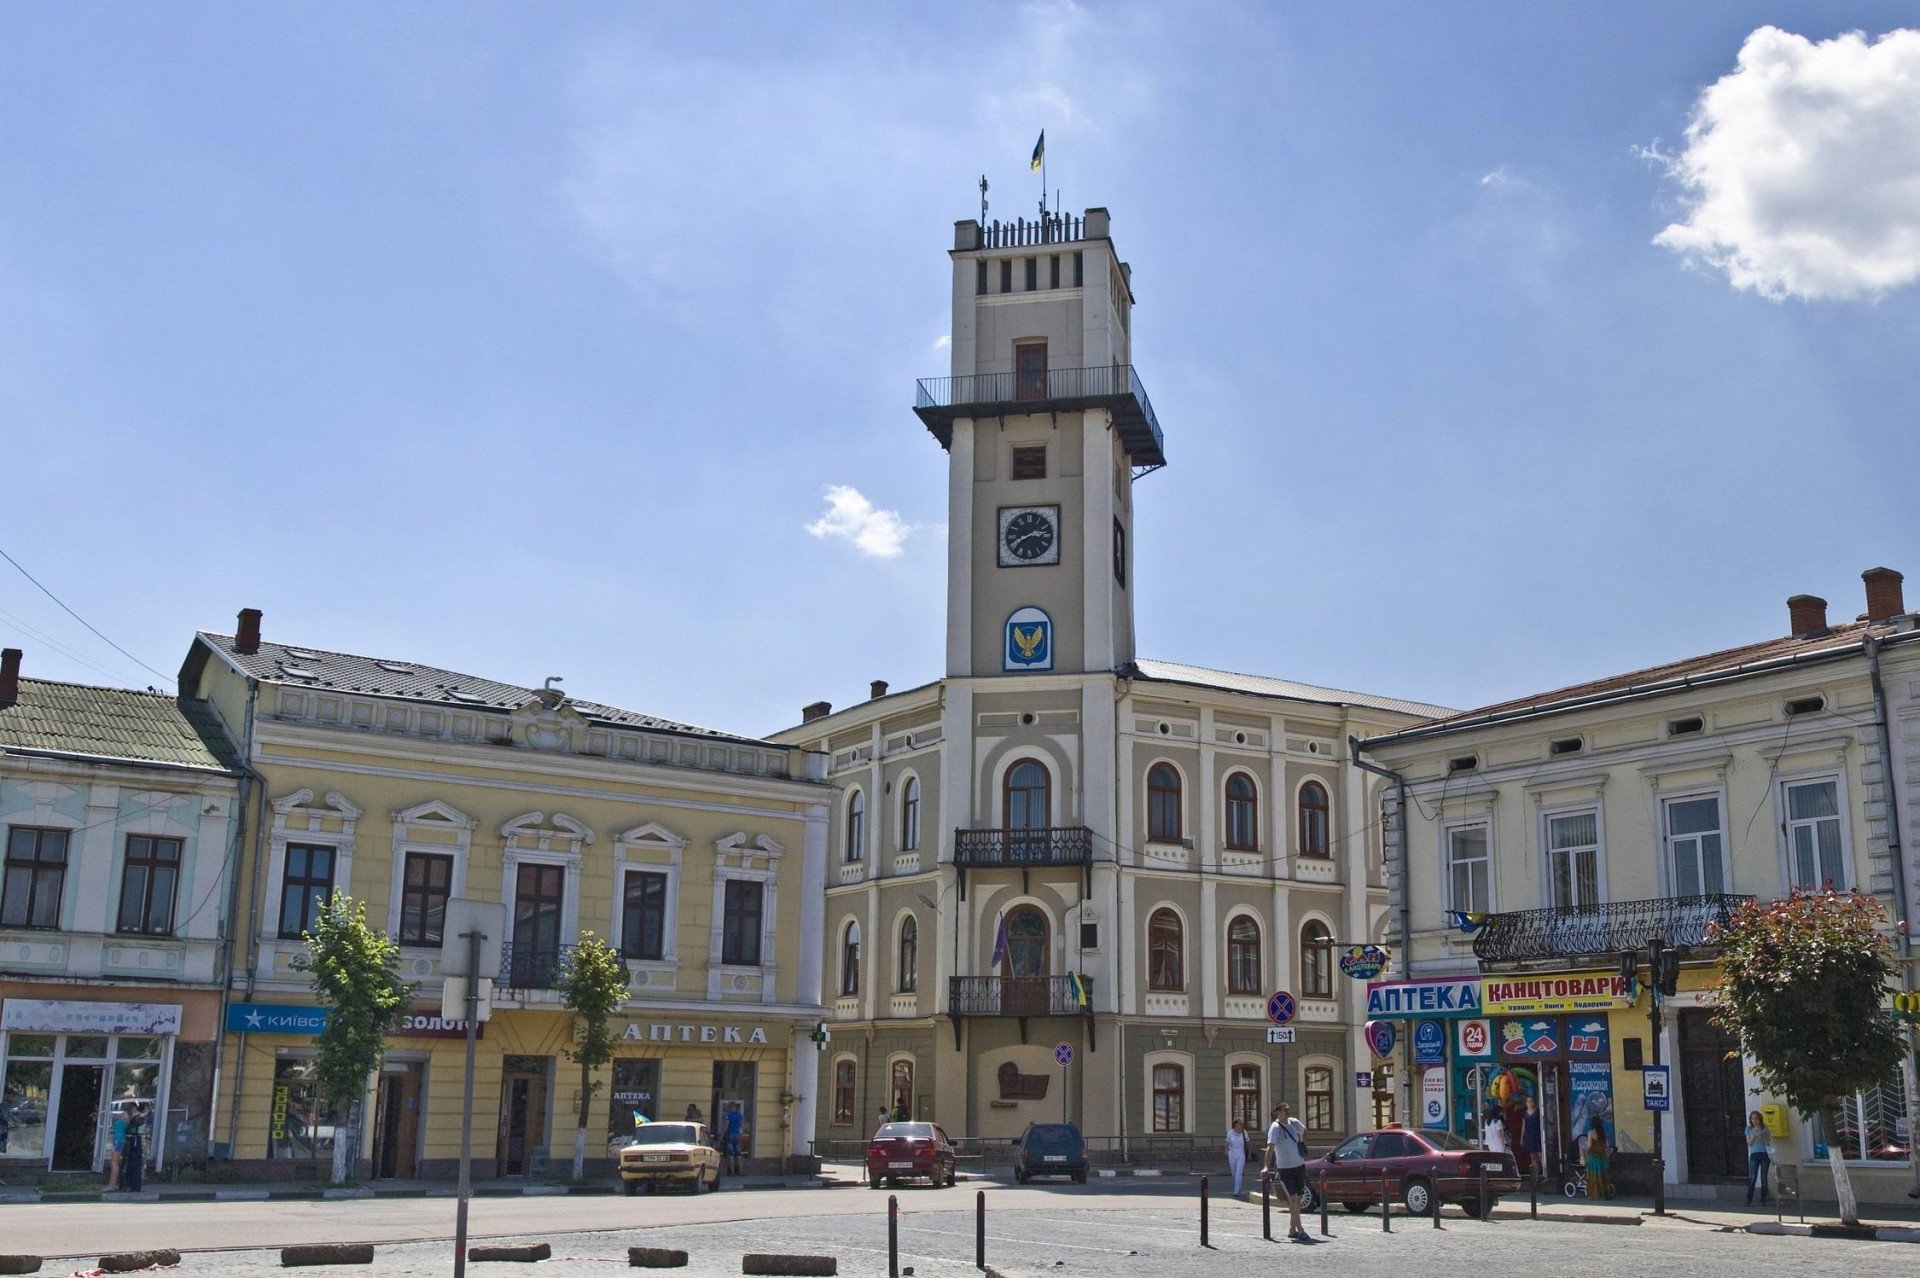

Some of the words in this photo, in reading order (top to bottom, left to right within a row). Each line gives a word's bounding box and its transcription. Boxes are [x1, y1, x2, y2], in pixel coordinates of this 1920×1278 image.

[1488, 976, 1627, 1003] КАНЦТОВАРИ
[1367, 985, 1477, 1013] АПТЕКА
[1573, 1001, 1613, 1009] Подарунки
[268, 1015, 343, 1028] КИЇВСТ
[622, 1023, 768, 1044] АПТЕКА
[1466, 1027, 1484, 1042] 24
[1568, 1060, 1611, 1076] Канцтовари
[1571, 1077, 1608, 1093] Ксерокопія
[613, 1092, 651, 1100] АПТЕКА
[272, 1086, 288, 1139] ЗОЛОТО
[1429, 1103, 1440, 1111] 24
